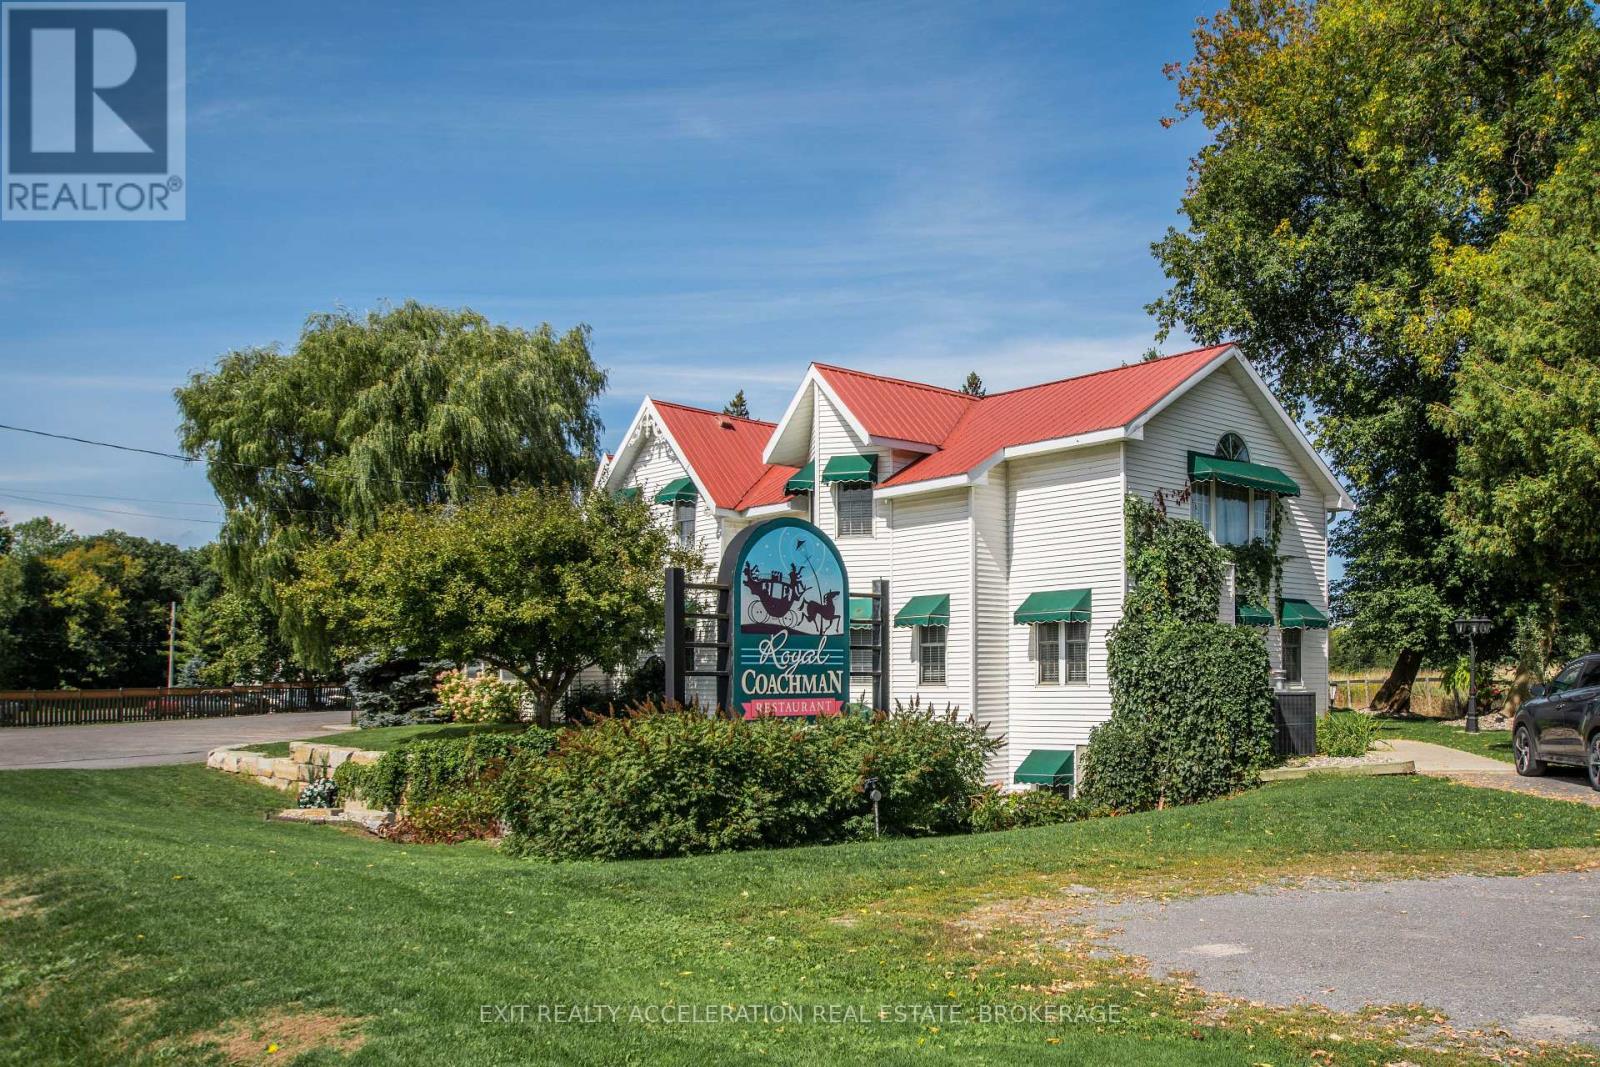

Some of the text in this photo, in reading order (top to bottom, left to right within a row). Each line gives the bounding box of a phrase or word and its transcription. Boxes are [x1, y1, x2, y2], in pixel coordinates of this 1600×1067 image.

[759, 629, 829, 677] Royal
[741, 669, 843, 695] COACHMAN
[755, 700, 832, 713] RESTAURANT
